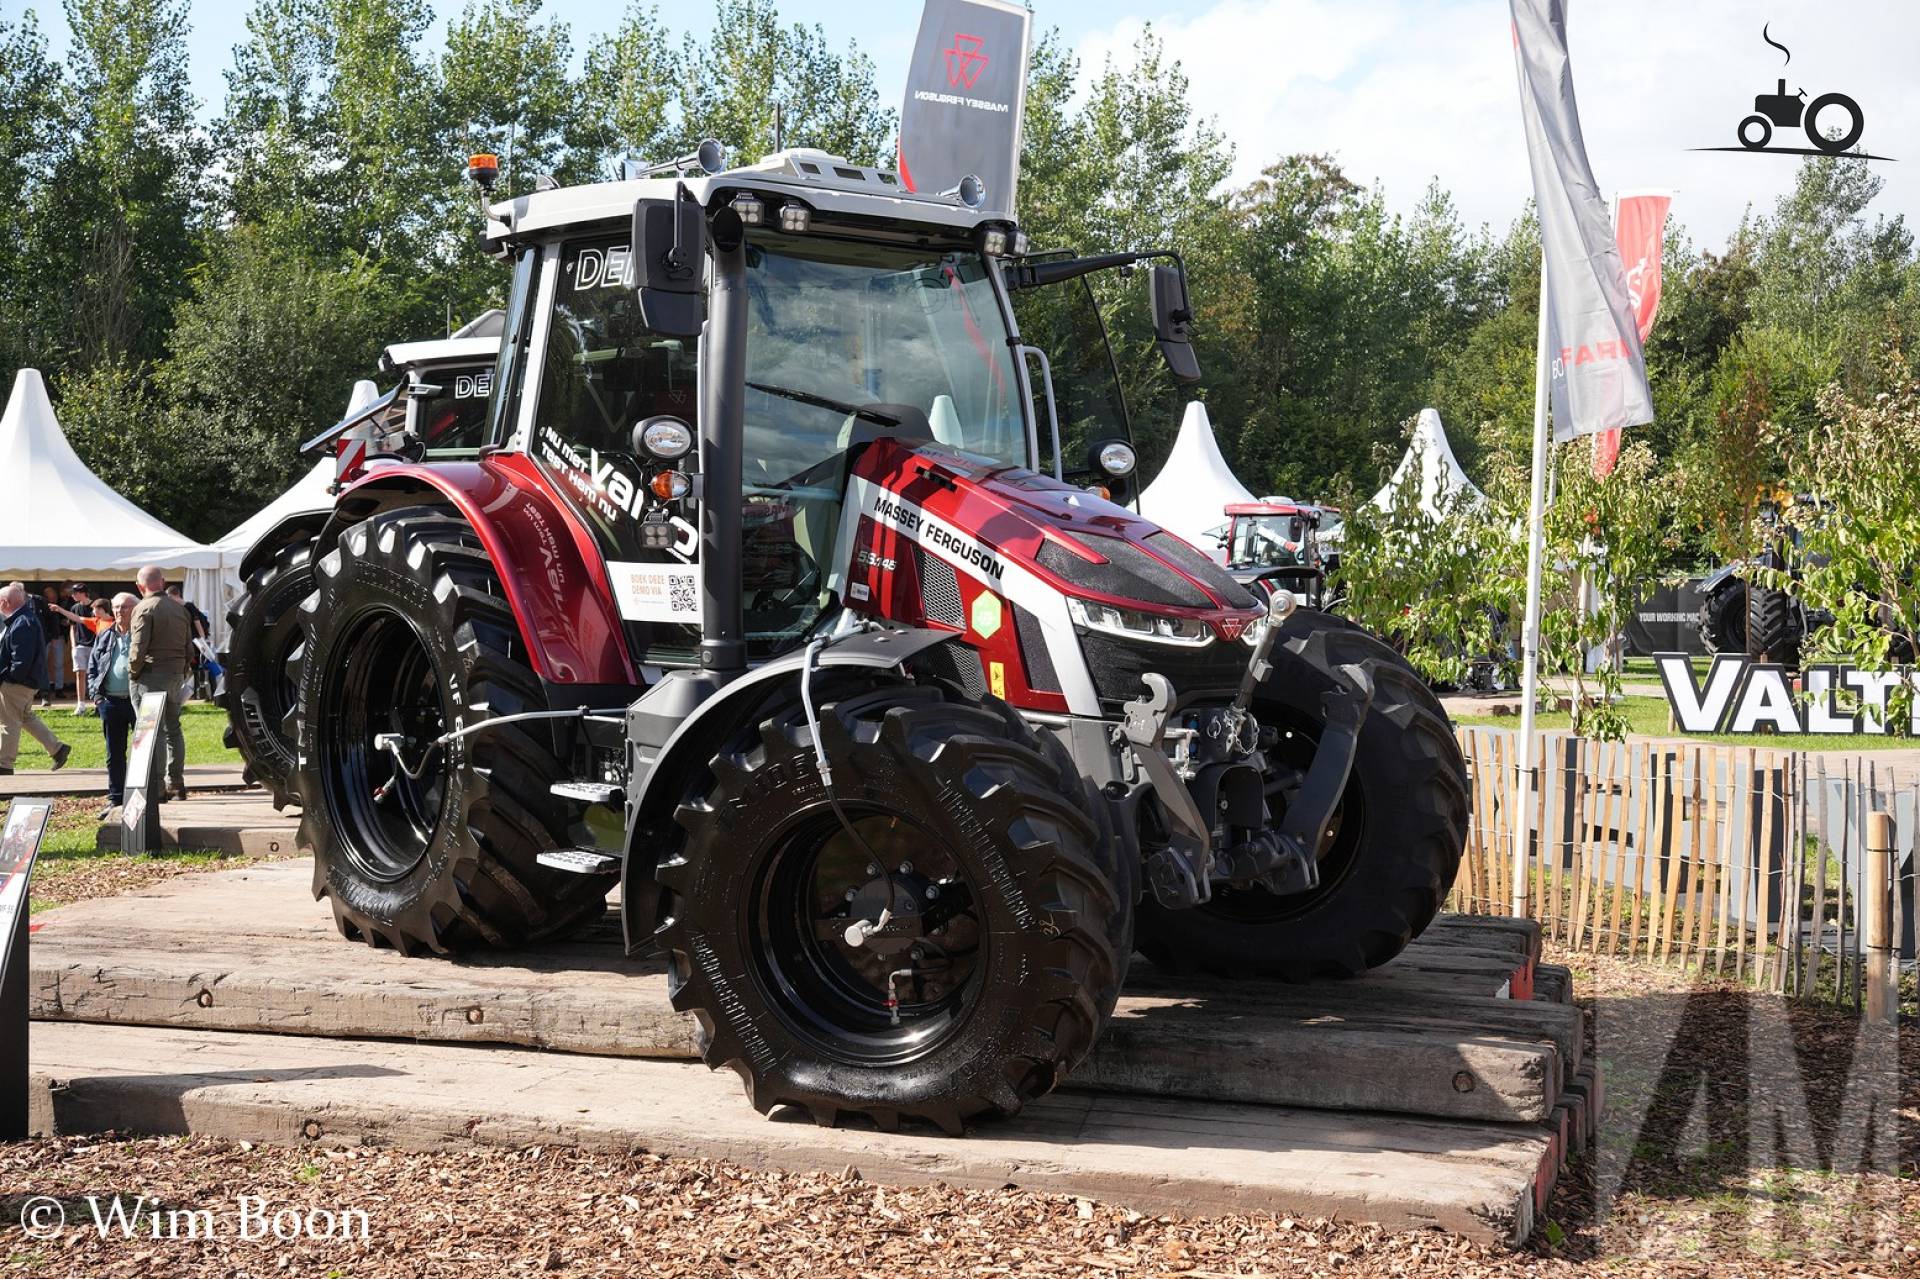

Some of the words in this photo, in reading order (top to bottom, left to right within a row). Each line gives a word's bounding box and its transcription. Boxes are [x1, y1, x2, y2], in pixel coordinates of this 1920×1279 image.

[873, 496, 925, 533] MASSEY
[925, 523, 1005, 581] FERGUSON
[1639, 612, 1656, 622] YOUR
[1657, 612, 1686, 622] WORKING
[1653, 652, 1920, 736] VALT
